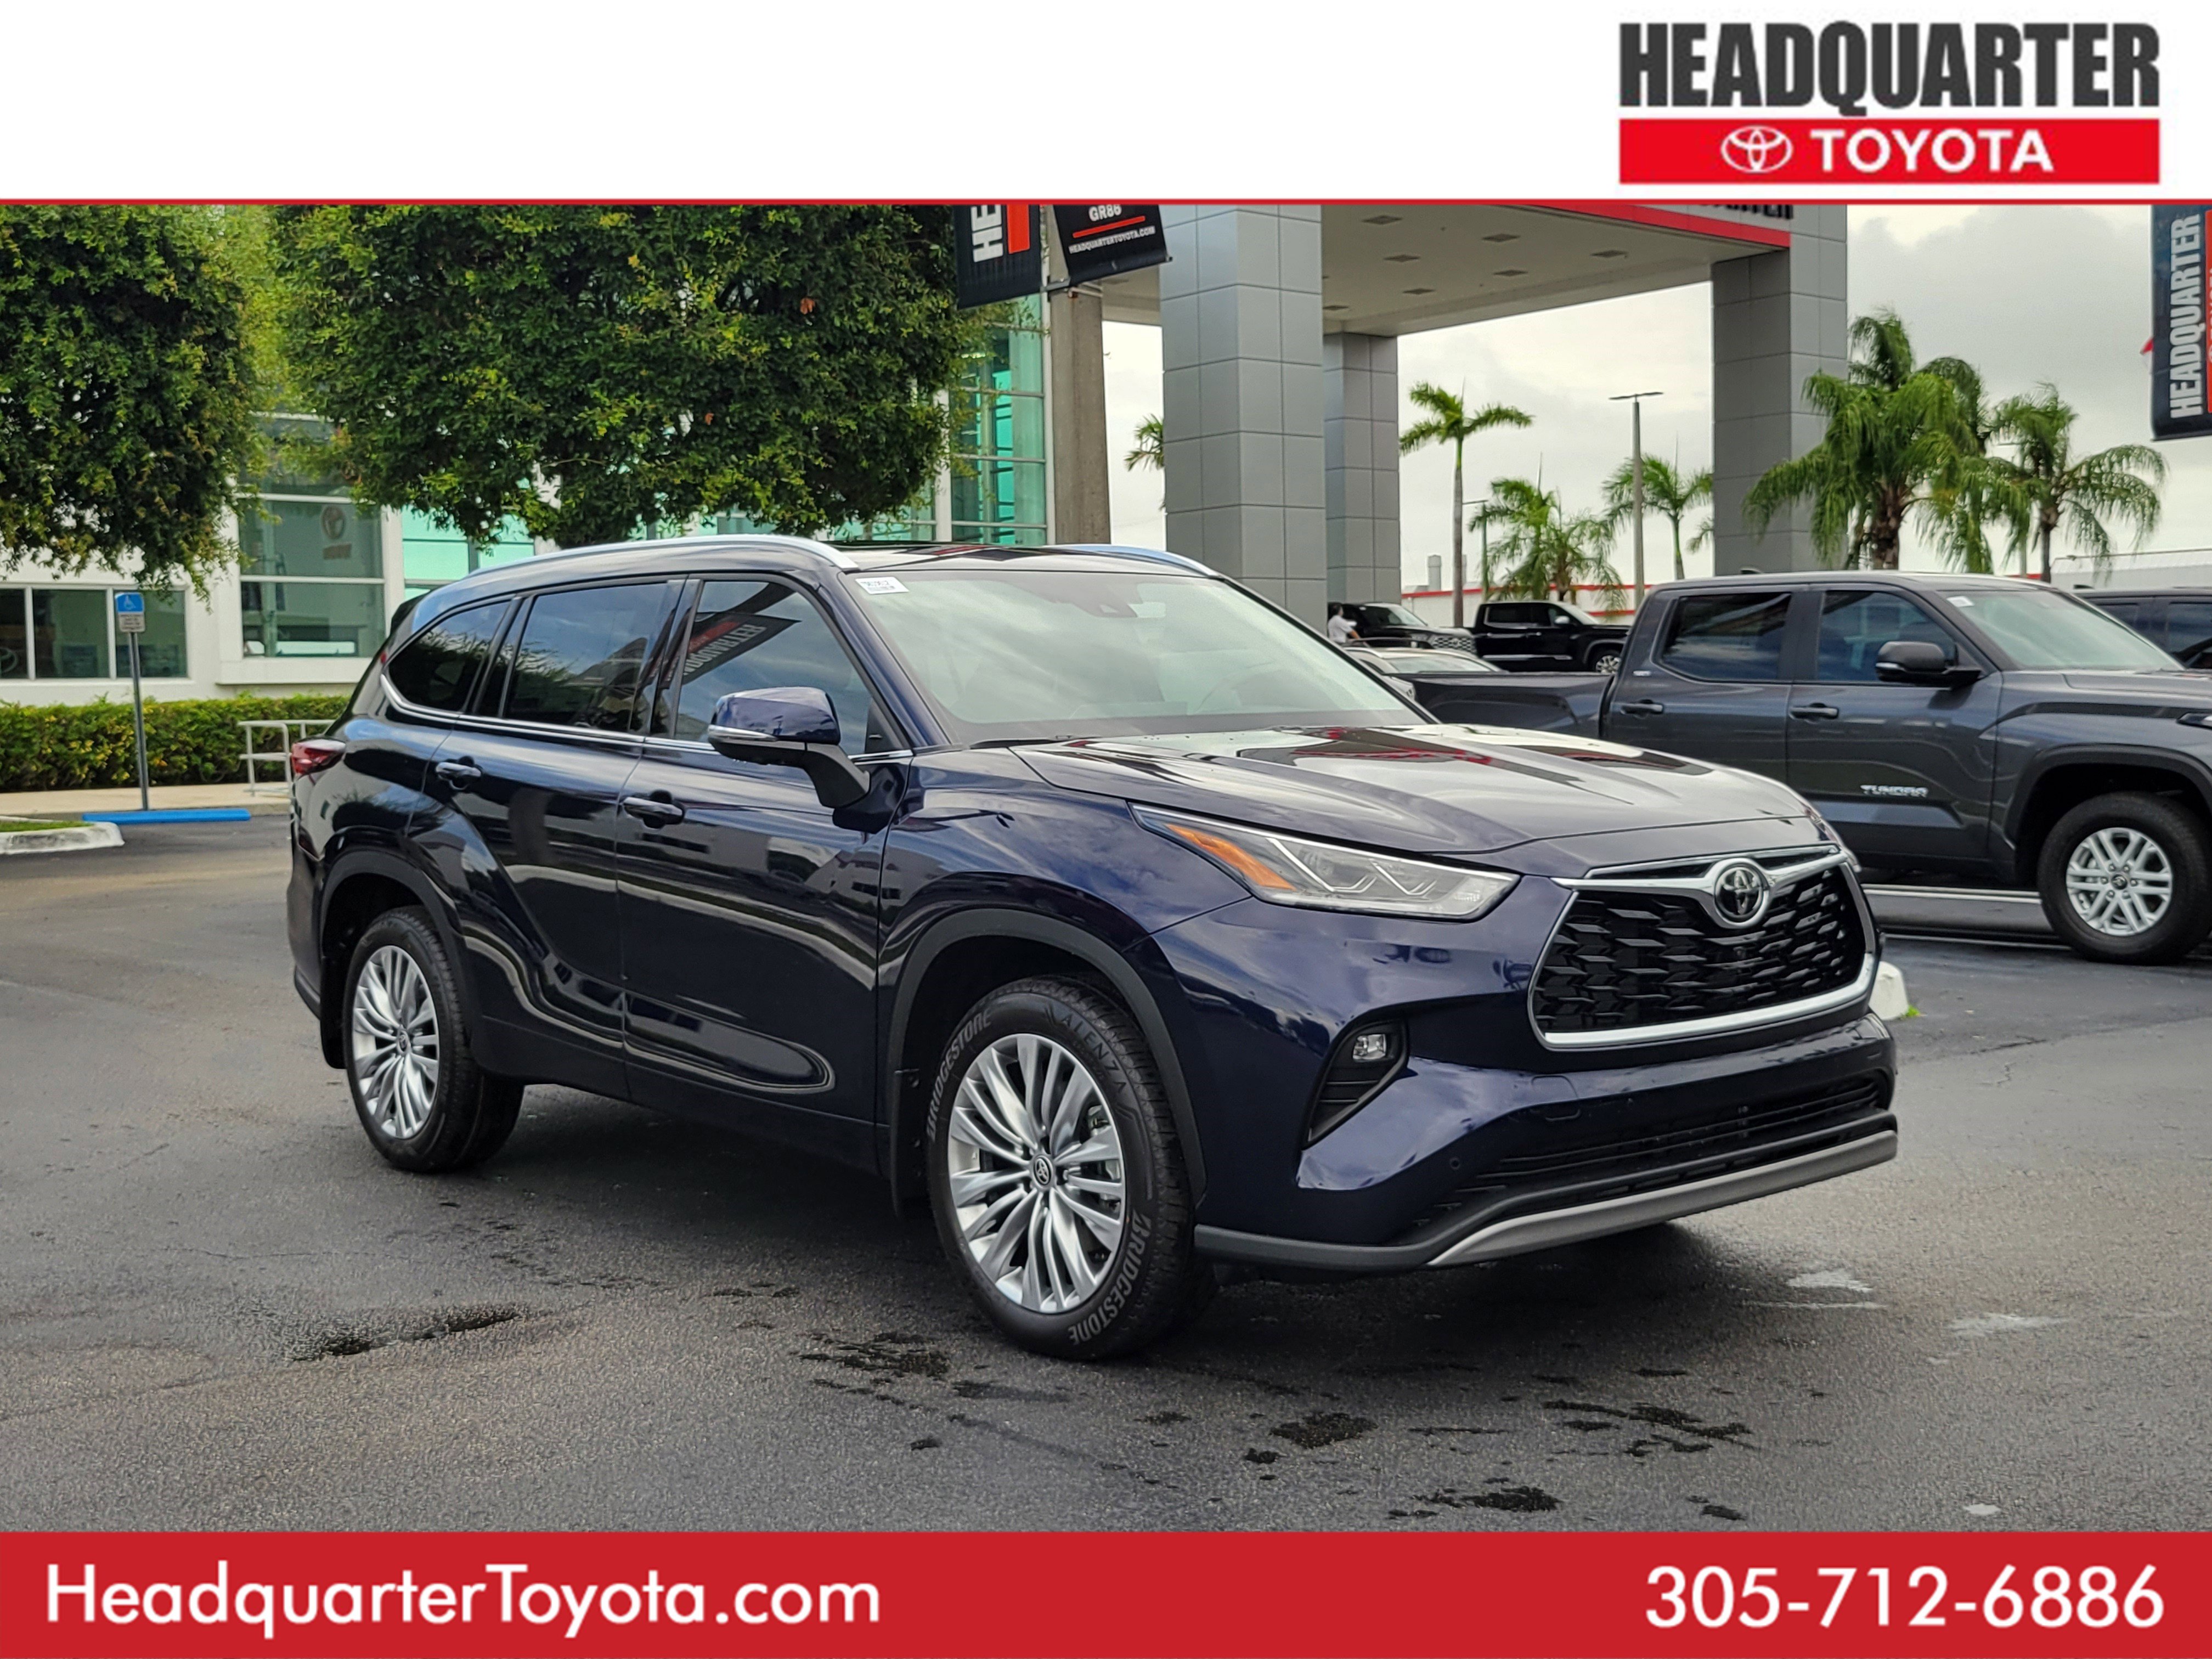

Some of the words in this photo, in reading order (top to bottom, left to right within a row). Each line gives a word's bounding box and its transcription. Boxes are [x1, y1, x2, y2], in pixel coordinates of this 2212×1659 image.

[1068, 225, 1156, 254] HEADQUARTERTOYOTA.COM
[2170, 214, 2206, 419] HEADQUARTER
[1860, 785, 1929, 798] TUNDRA
[927, 1009, 991, 1142] BRIDGESTONE
[1068, 1209, 1152, 1345] BRIDGESTONE
